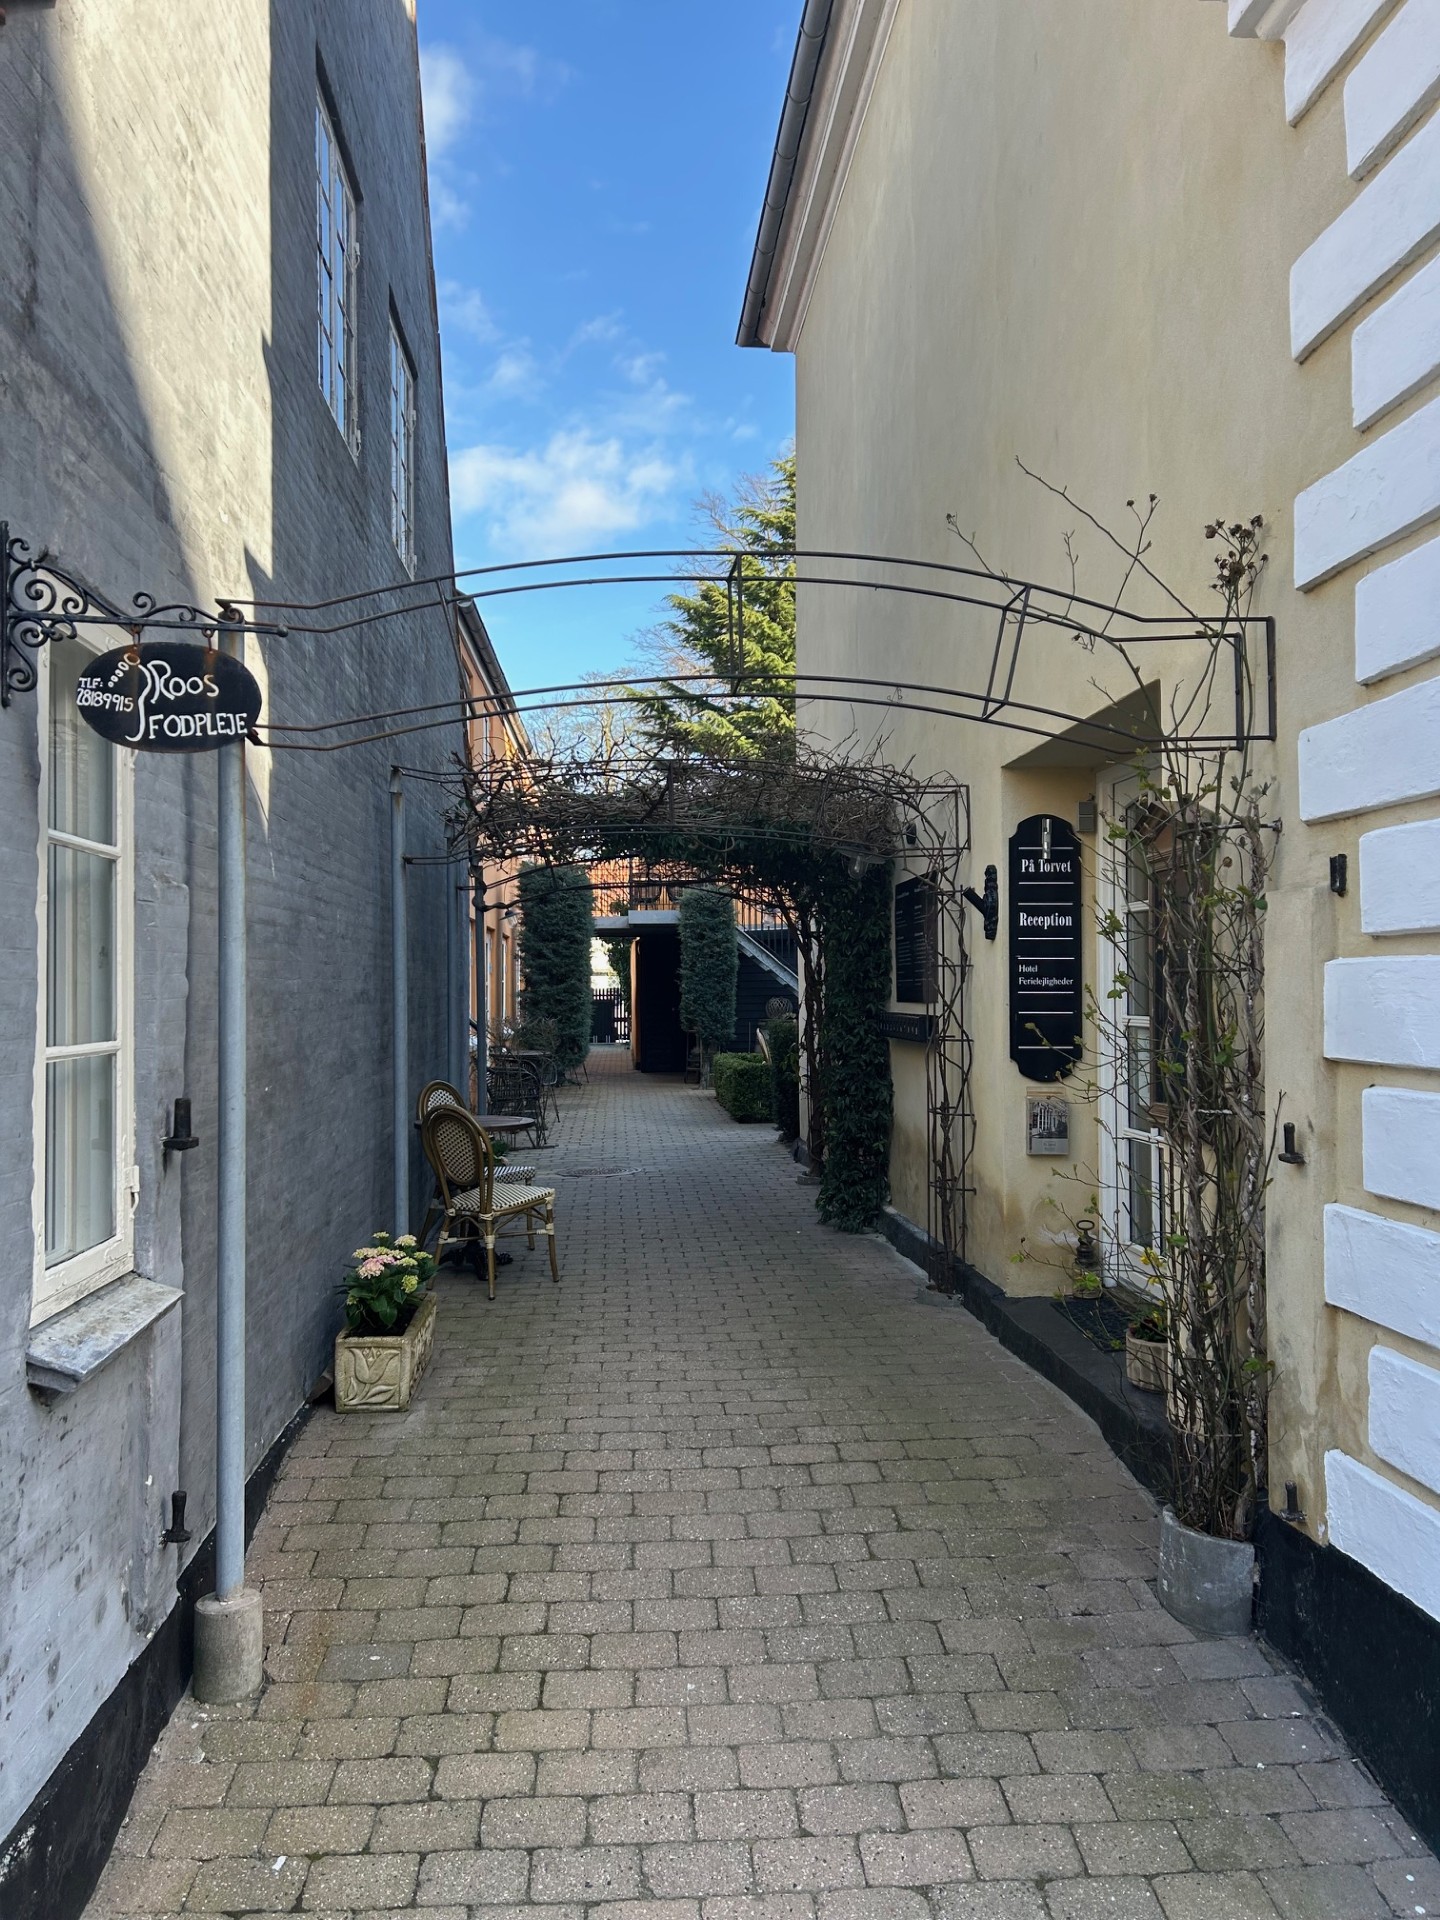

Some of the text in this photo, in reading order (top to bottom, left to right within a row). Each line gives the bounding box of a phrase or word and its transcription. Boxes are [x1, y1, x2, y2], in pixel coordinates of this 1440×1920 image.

[78, 676, 103, 689] TLF:
[147, 660, 220, 704] Roos
[76, 687, 134, 713] 28189915
[149, 713, 248, 740] FODPLEJE
[1021, 858, 1072, 873] På Torvet
[1019, 912, 1073, 930] Reception
[1018, 964, 1038, 973] Hotel
[1018, 976, 1074, 987] Ferielejligheder
